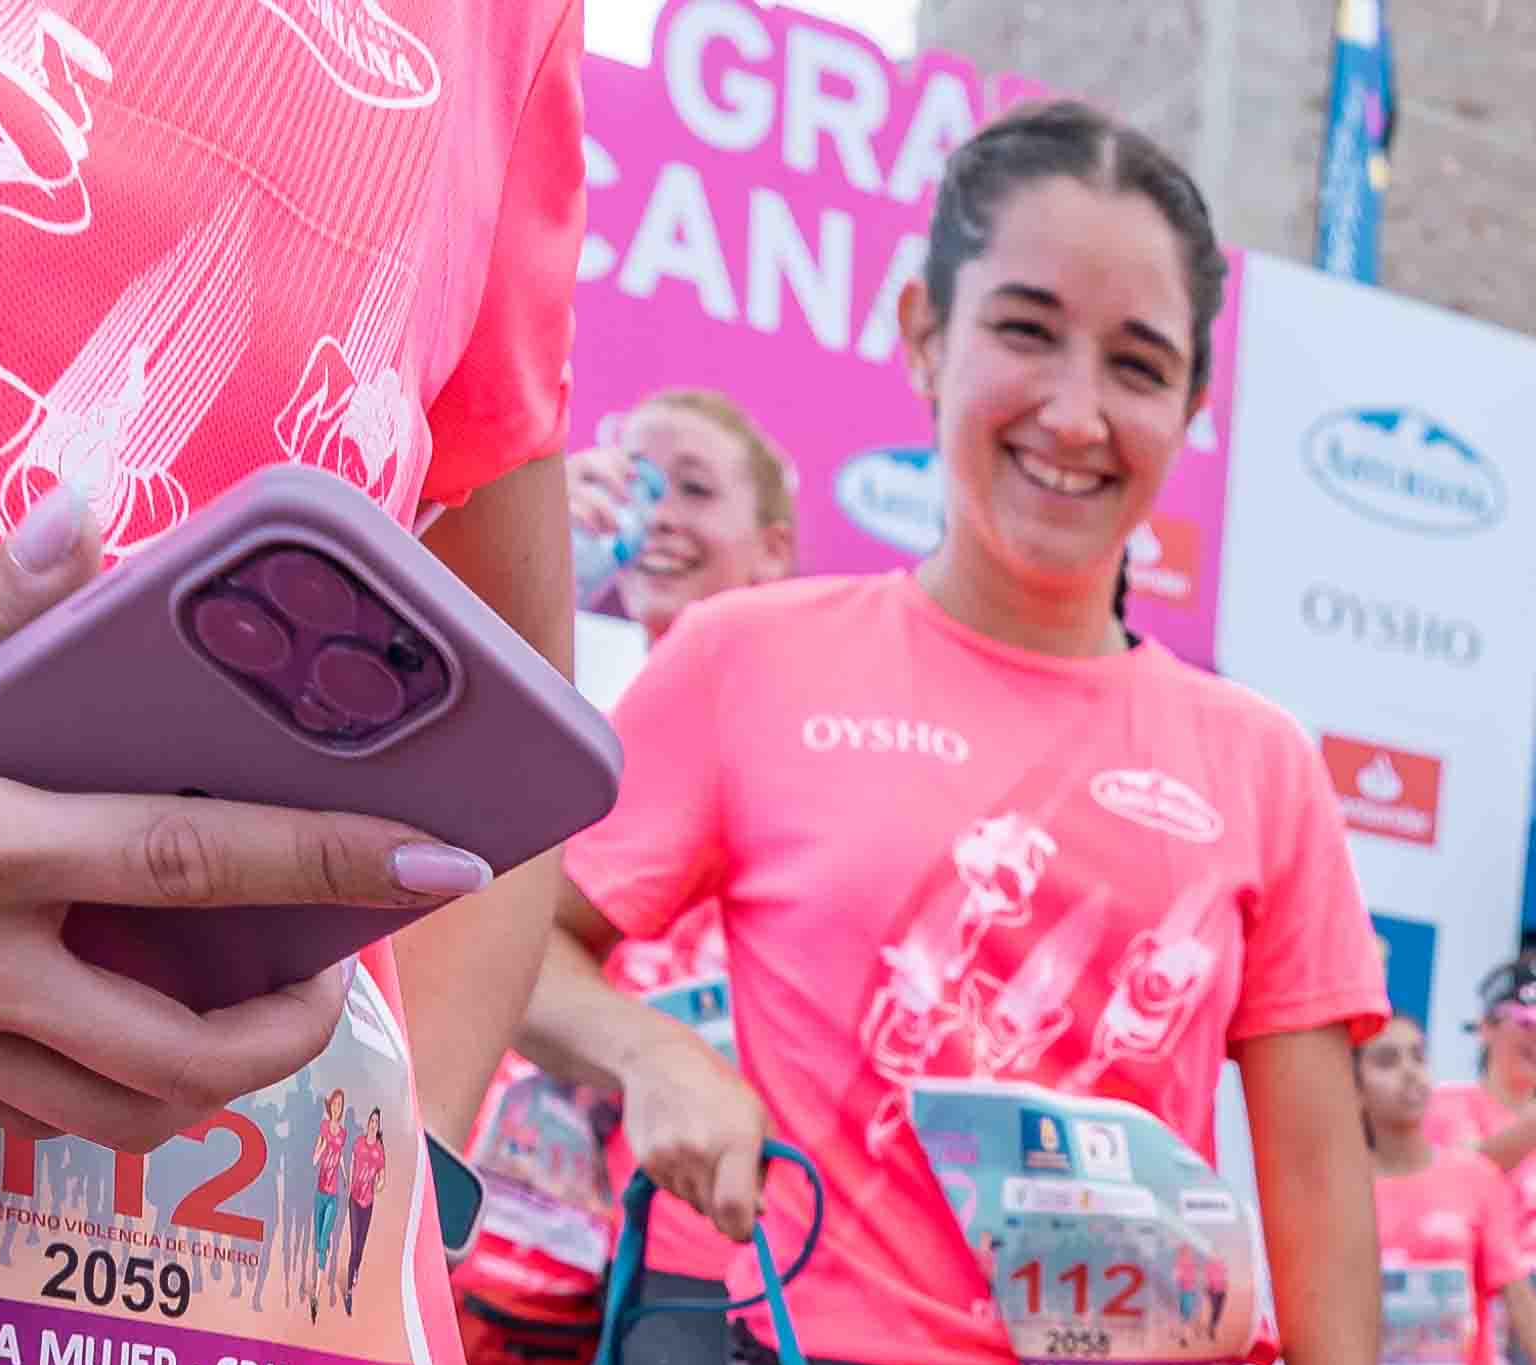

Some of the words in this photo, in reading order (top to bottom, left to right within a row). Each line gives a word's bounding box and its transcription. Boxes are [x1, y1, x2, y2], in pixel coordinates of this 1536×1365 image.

[665, 0, 976, 204] GRA
[1300, 580, 1484, 670] OYSHO
[802, 713, 970, 763] OYSHO
[64, 1219, 162, 1250] VIOLENCIA
[165, 1238, 188, 1256] DE
[40, 1242, 191, 1319] 2059
[1011, 1257, 1147, 1319] 112
